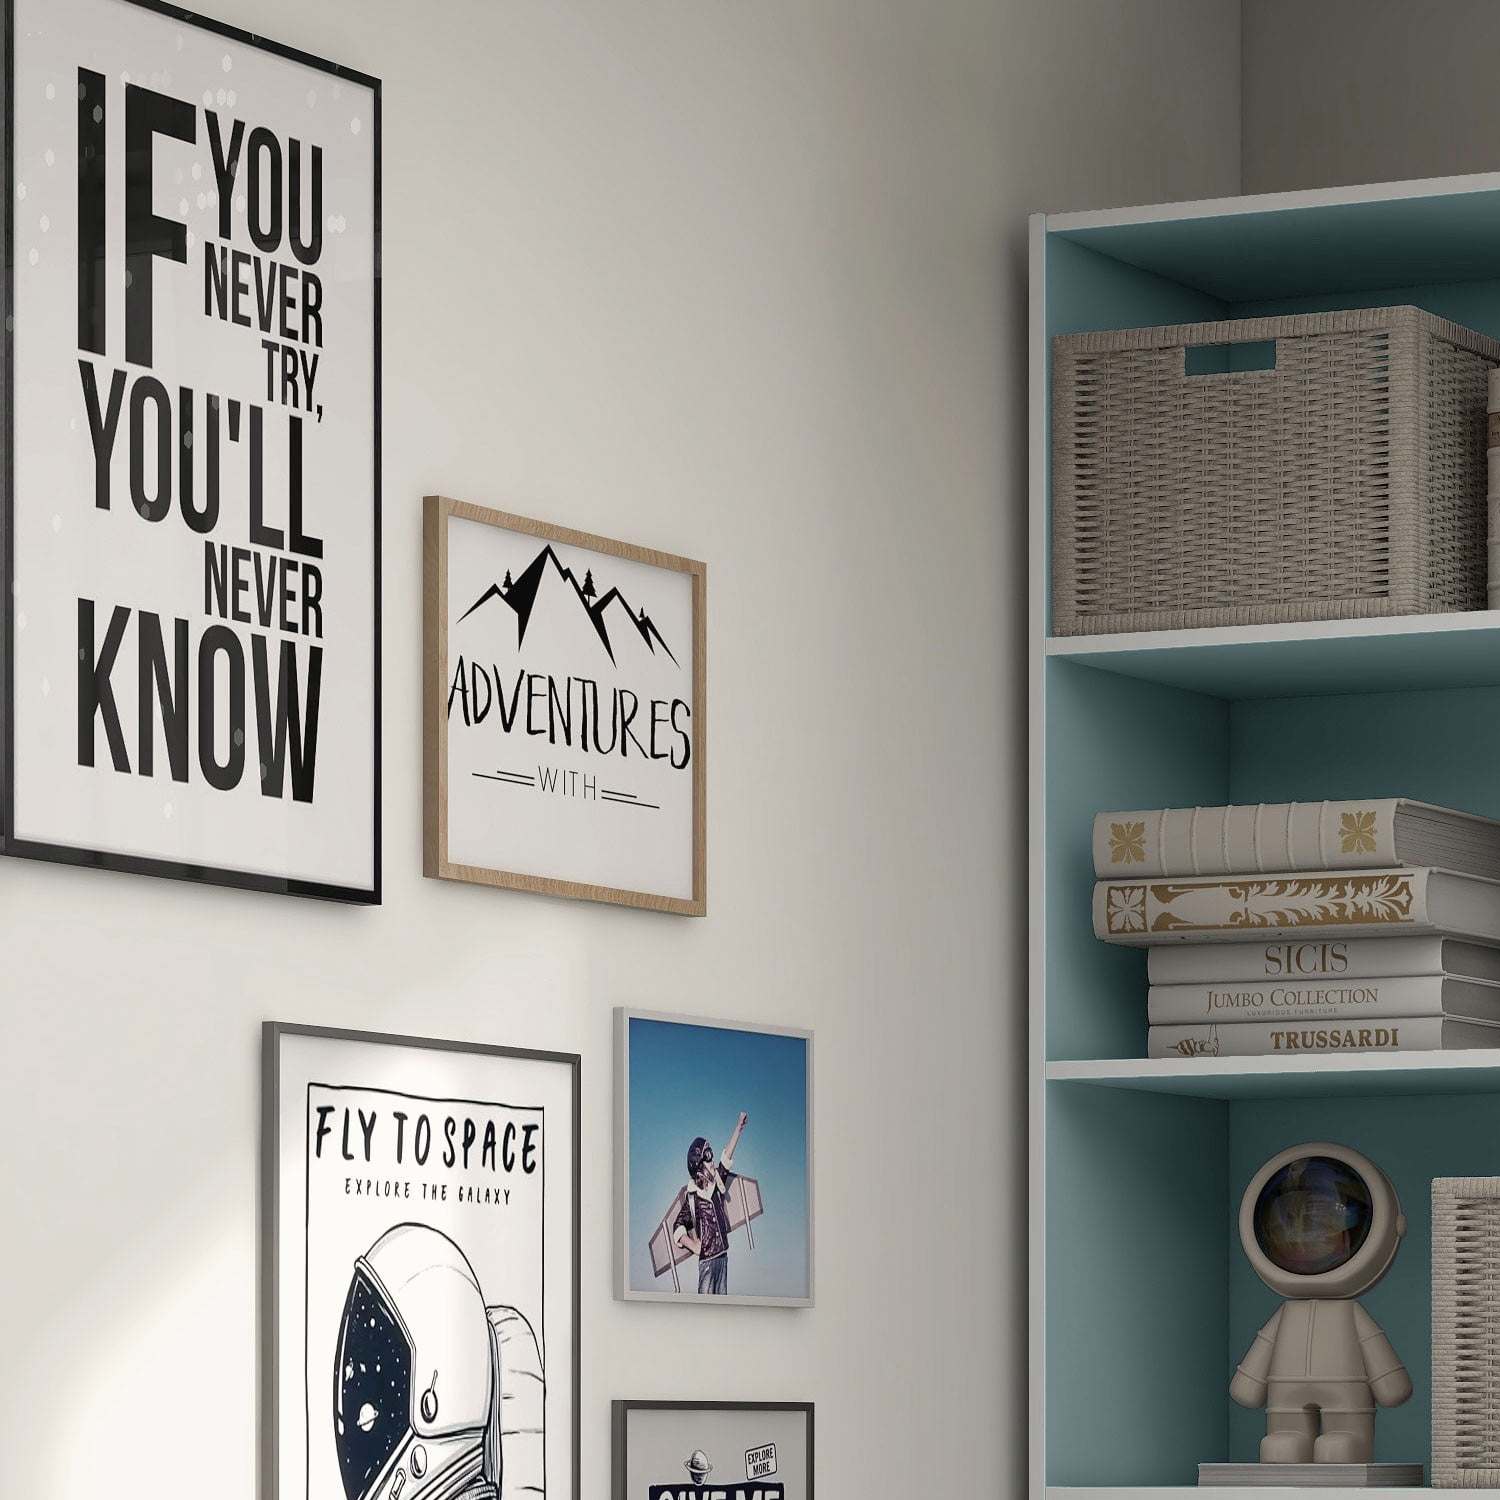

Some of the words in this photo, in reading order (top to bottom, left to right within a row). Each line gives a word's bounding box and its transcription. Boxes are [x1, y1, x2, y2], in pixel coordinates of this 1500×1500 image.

[77, 66, 197, 369] IF
[205, 109, 323, 265] YOU
[205, 242, 323, 348] NEVER
[262, 339, 323, 424] TRY,
[78, 359, 324, 559] YOU'LL
[205, 541, 323, 640] NEVER
[78, 598, 323, 804] KNOW
[448, 655, 692, 770] ADVENTURES
[539, 765, 597, 801] WITH
[1264, 943, 1349, 975] SICIS
[1206, 989, 1264, 1013] JUMBO
[1270, 986, 1379, 1007] COLLECTION
[1270, 1028, 1399, 1050] TRUSSARDI
[315, 1105, 375, 1165] FLY
[392, 1111, 432, 1167] TO
[442, 1116, 538, 1175] SPACE
[345, 1178, 411, 1200] EXPLORE
[422, 1182, 448, 1201] THE
[458, 1185, 511, 1205] GALAXY
[747, 1448, 773, 1465] EXPLORE
[753, 1461, 770, 1476] MORE
